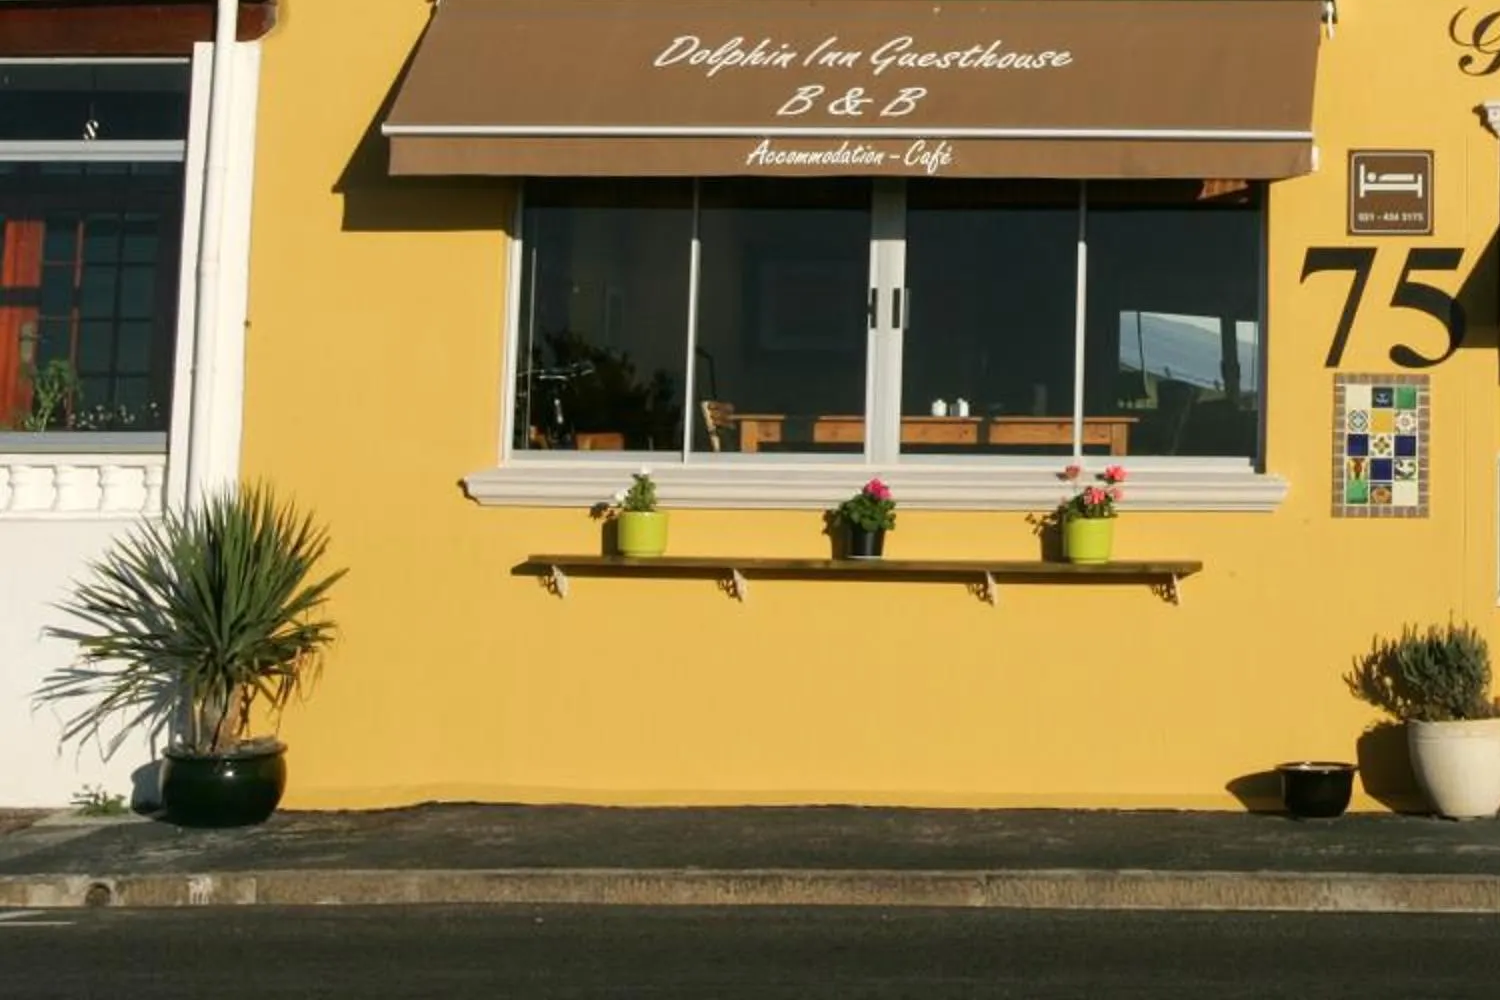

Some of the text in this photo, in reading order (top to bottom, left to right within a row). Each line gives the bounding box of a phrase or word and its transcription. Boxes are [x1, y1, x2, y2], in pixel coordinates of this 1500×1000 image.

[653, 35, 1074, 76] Dolphin Inn Guesthouse
[776, 84, 928, 117] B & B
[745, 138, 886, 166] Accommodation
[903, 139, 953, 175] Café
[1299, 246, 1467, 369] 75
